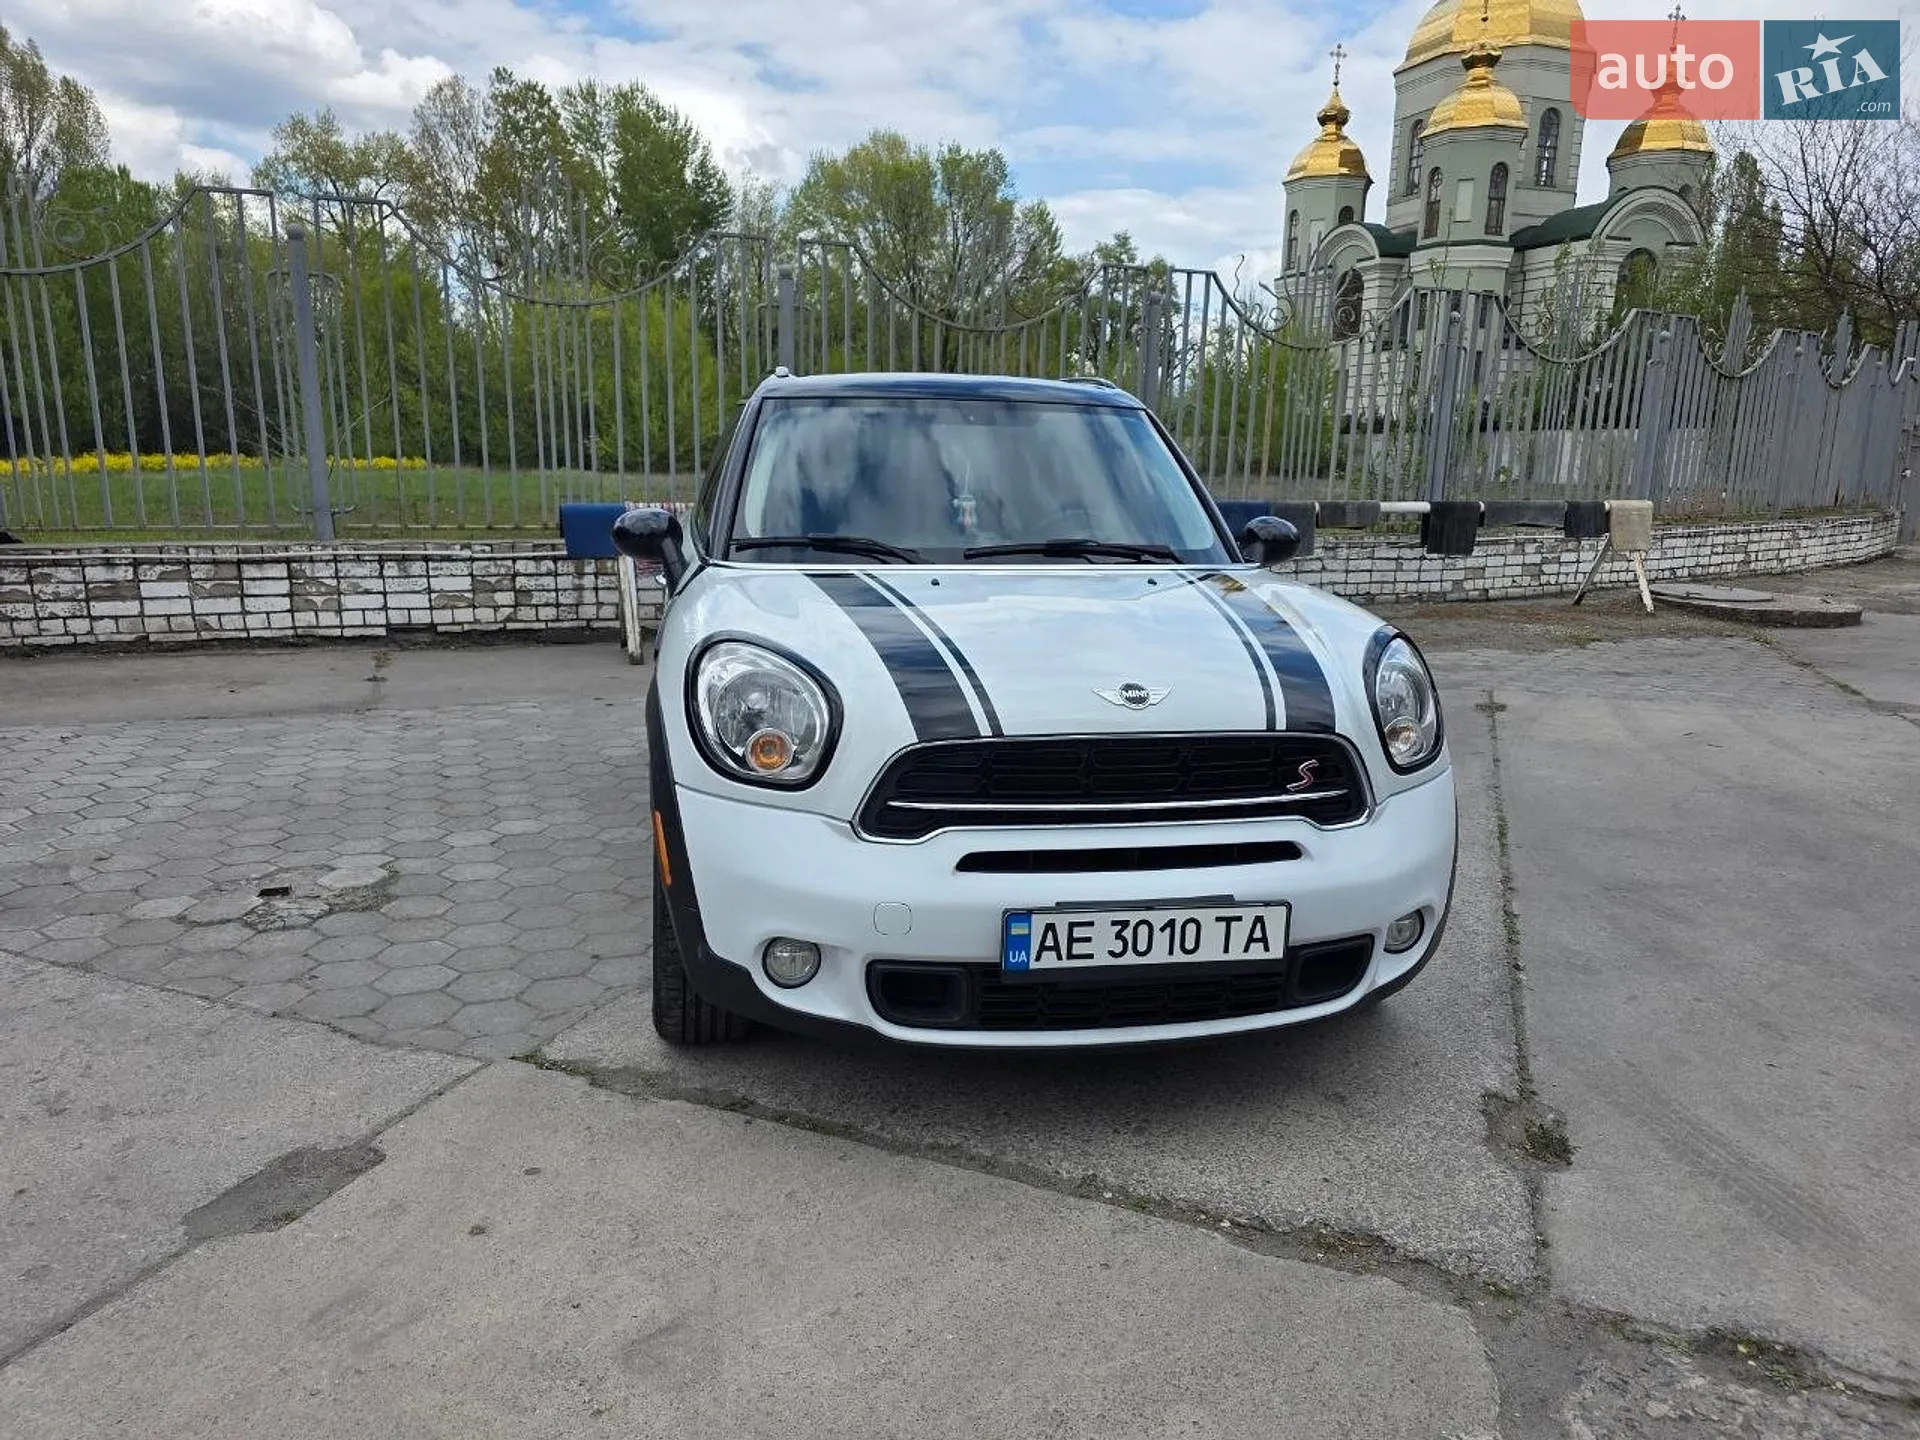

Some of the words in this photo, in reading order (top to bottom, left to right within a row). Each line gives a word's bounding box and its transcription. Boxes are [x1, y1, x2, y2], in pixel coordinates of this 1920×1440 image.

[1121, 689, 1148, 698] MINI
[1034, 920, 1095, 962] AE
[1107, 917, 1202, 959] 3010
[1215, 914, 1271, 954] TA
[1009, 950, 1028, 963] UA
